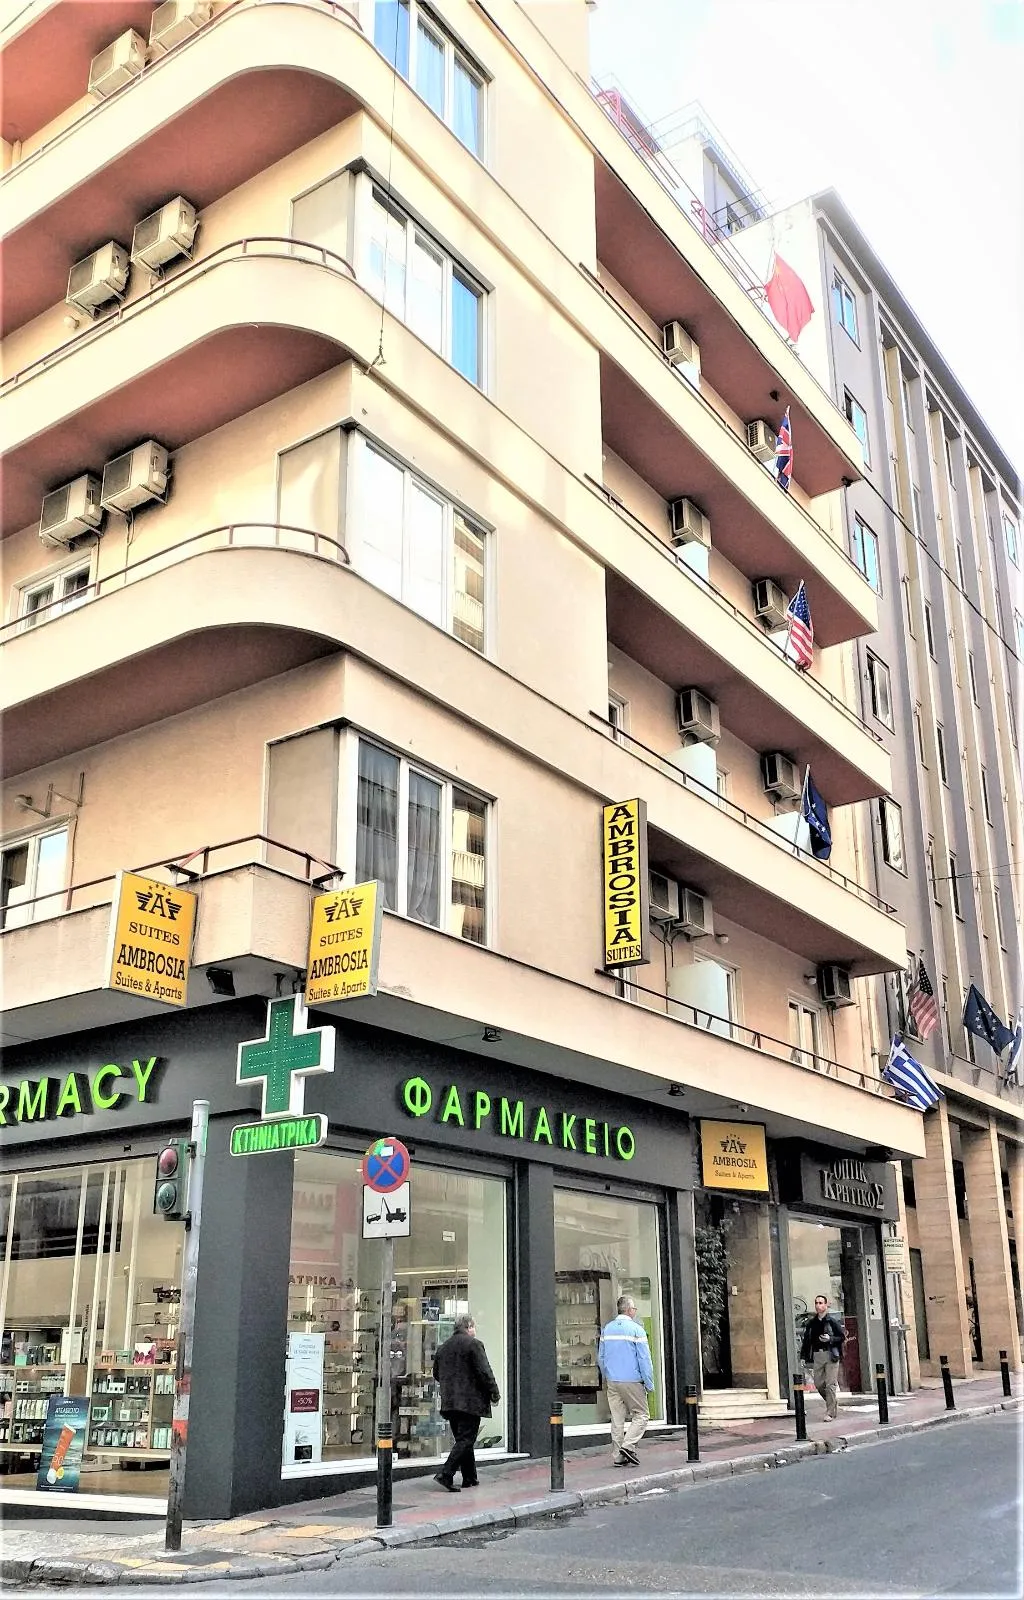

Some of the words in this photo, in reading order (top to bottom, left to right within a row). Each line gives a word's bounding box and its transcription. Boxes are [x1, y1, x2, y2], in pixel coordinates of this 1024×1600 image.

[607, 804, 637, 946] AMBROSIA
[129, 921, 180, 945] SUITES
[319, 927, 363, 947] SUITES
[116, 943, 186, 981] AMBROSIA
[310, 949, 368, 980] AMBROSIA
[606, 944, 641, 962] SUITES
[115, 971, 144, 992] Suites
[144, 980, 152, 993] &
[152, 980, 183, 1000] Aparts
[308, 984, 332, 1001] Suites
[333, 983, 340, 995] &
[340, 980, 367, 996] Aparts
[403, 1076, 636, 1161] ΦΑΡΜΑΚΕΙΟ
[233, 1118, 317, 1153] ΚΤΗΝΙΑΤΡΙΚΑ
[713, 1155, 758, 1169] AMBROSIA
[823, 1170, 885, 1210] ΚΡΗΤΙΚΟΣ
